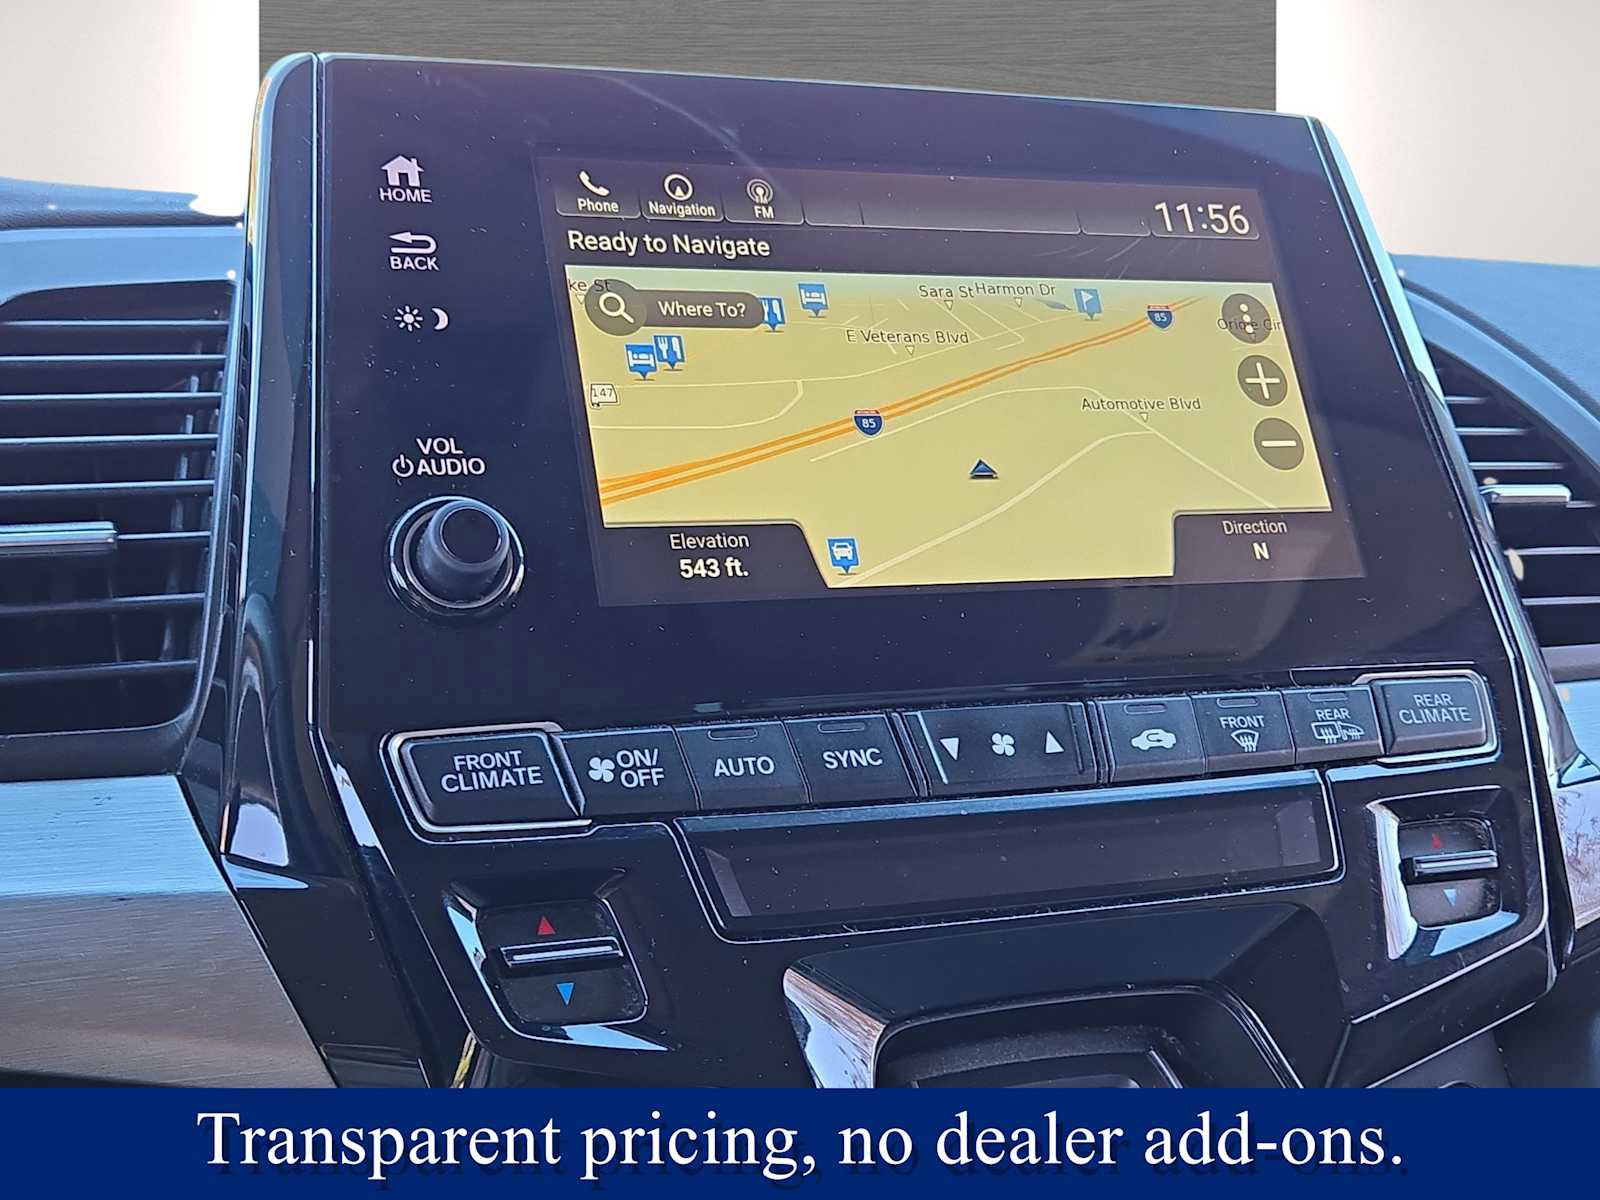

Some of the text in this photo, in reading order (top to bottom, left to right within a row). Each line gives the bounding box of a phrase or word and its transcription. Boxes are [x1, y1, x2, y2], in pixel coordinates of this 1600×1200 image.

[379, 187, 433, 203] HOME
[577, 198, 619, 213] Phone
[649, 201, 716, 219] Navigation
[754, 206, 774, 220] FM
[1154, 201, 1250, 236] 11:56
[567, 230, 770, 259] Ready to Navigate
[389, 255, 440, 271] BACK
[919, 285, 974, 298] Sara St
[975, 283, 1056, 296] Harmon Dr
[658, 301, 746, 318] Where To?
[1154, 312, 1167, 322] 85
[846, 329, 969, 344] E Veterans Blvd
[592, 388, 613, 398] 147
[1082, 397, 1200, 413] Automotive Blvd
[862, 418, 876, 429] 85
[417, 437, 463, 455] VOL
[416, 457, 486, 477] AUDIO
[1222, 519, 1288, 535] Direction
[669, 532, 750, 550] Elevation
[1252, 542, 1270, 560] N
[680, 556, 749, 579] 543 ft.
[1413, 693, 1453, 709] REAR
[1219, 715, 1265, 729] FRONT
[1315, 708, 1351, 721] REAR
[1399, 706, 1473, 725] CLIMATE
[453, 749, 523, 772] FRONT
[616, 748, 659, 769] ON/
[713, 756, 776, 778] AUTO
[822, 748, 883, 770] SYNC
[440, 765, 544, 793] CLIMATE
[620, 767, 666, 789] OFF
